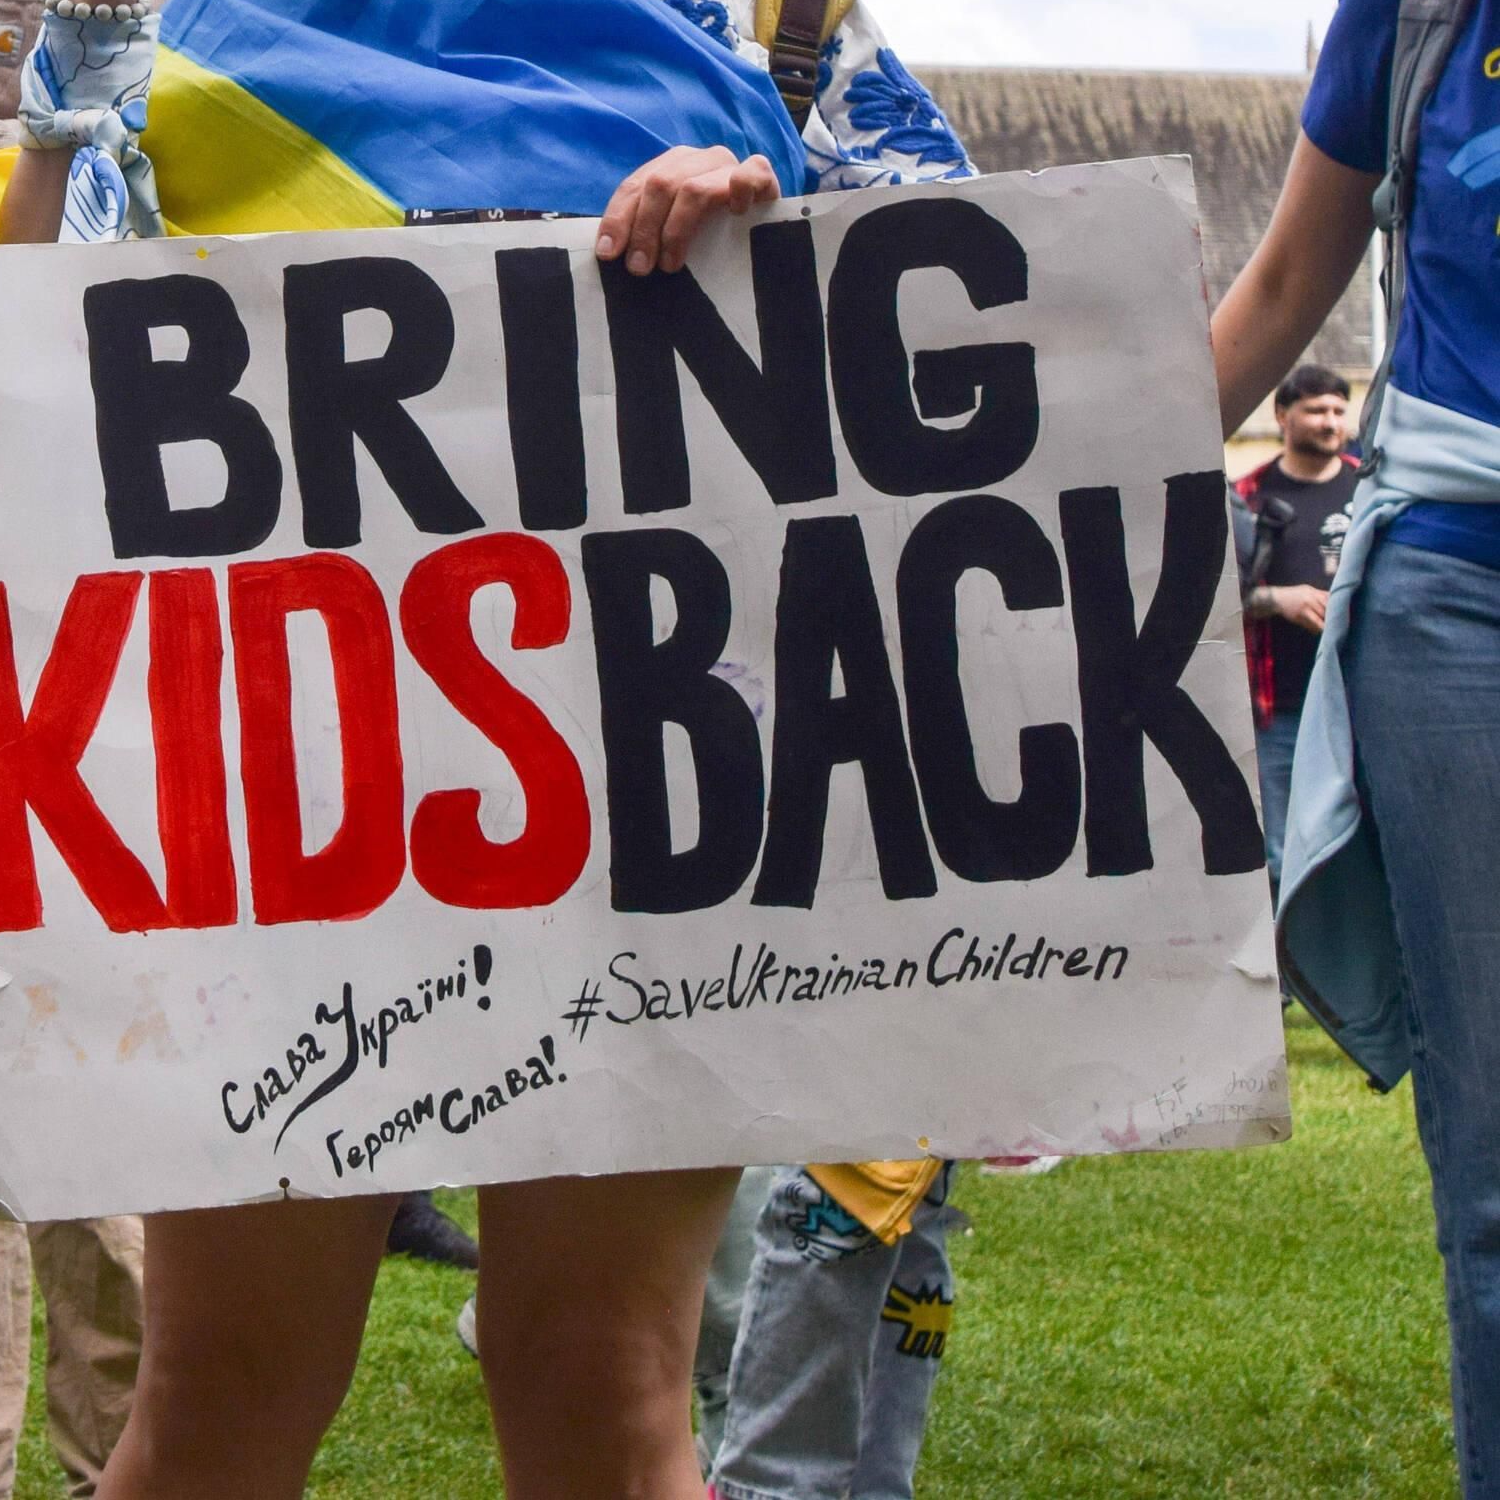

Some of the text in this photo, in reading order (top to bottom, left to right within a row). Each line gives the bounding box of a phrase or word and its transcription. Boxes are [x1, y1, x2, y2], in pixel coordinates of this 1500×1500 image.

[84, 199, 1037, 559] BRING
[586, 470, 1265, 912] BACK
[222, 944, 492, 1154] Слава Україні!
[326, 1035, 567, 1178] Героям Слава!
